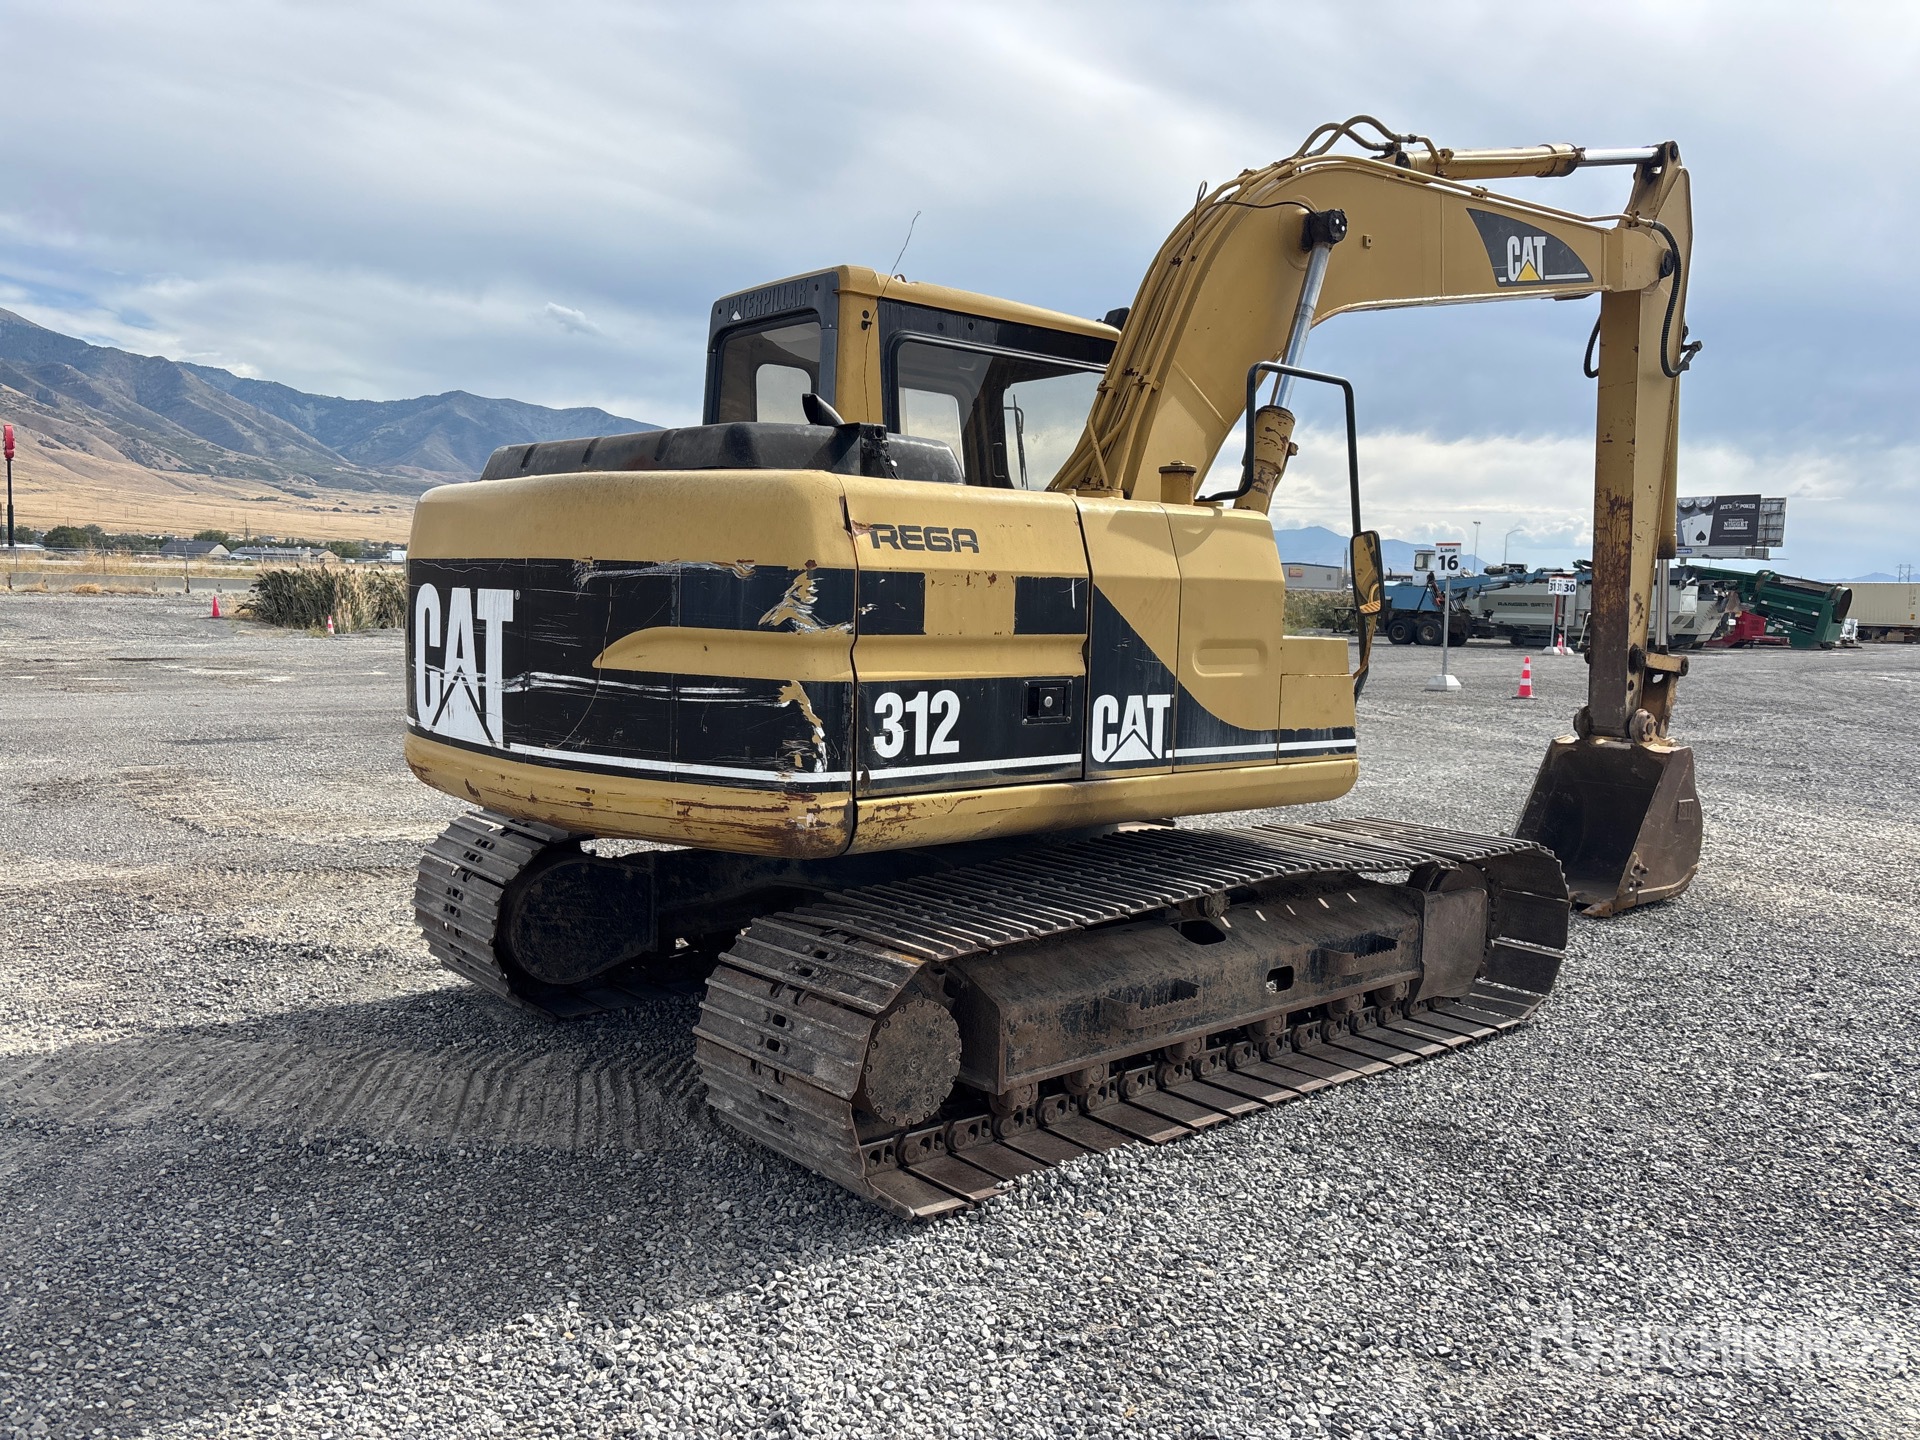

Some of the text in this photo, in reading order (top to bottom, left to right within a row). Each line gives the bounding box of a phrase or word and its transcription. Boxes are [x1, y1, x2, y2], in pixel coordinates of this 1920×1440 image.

[1507, 236, 1546, 282] CAT
[727, 282, 807, 321] CATERPILLAR
[869, 524, 979, 553] REGA
[1438, 555, 1459, 571] 16
[1564, 583, 1576, 593] 30
[415, 583, 514, 749] CAT
[873, 689, 961, 758] 312
[1092, 694, 1171, 763] CAT
